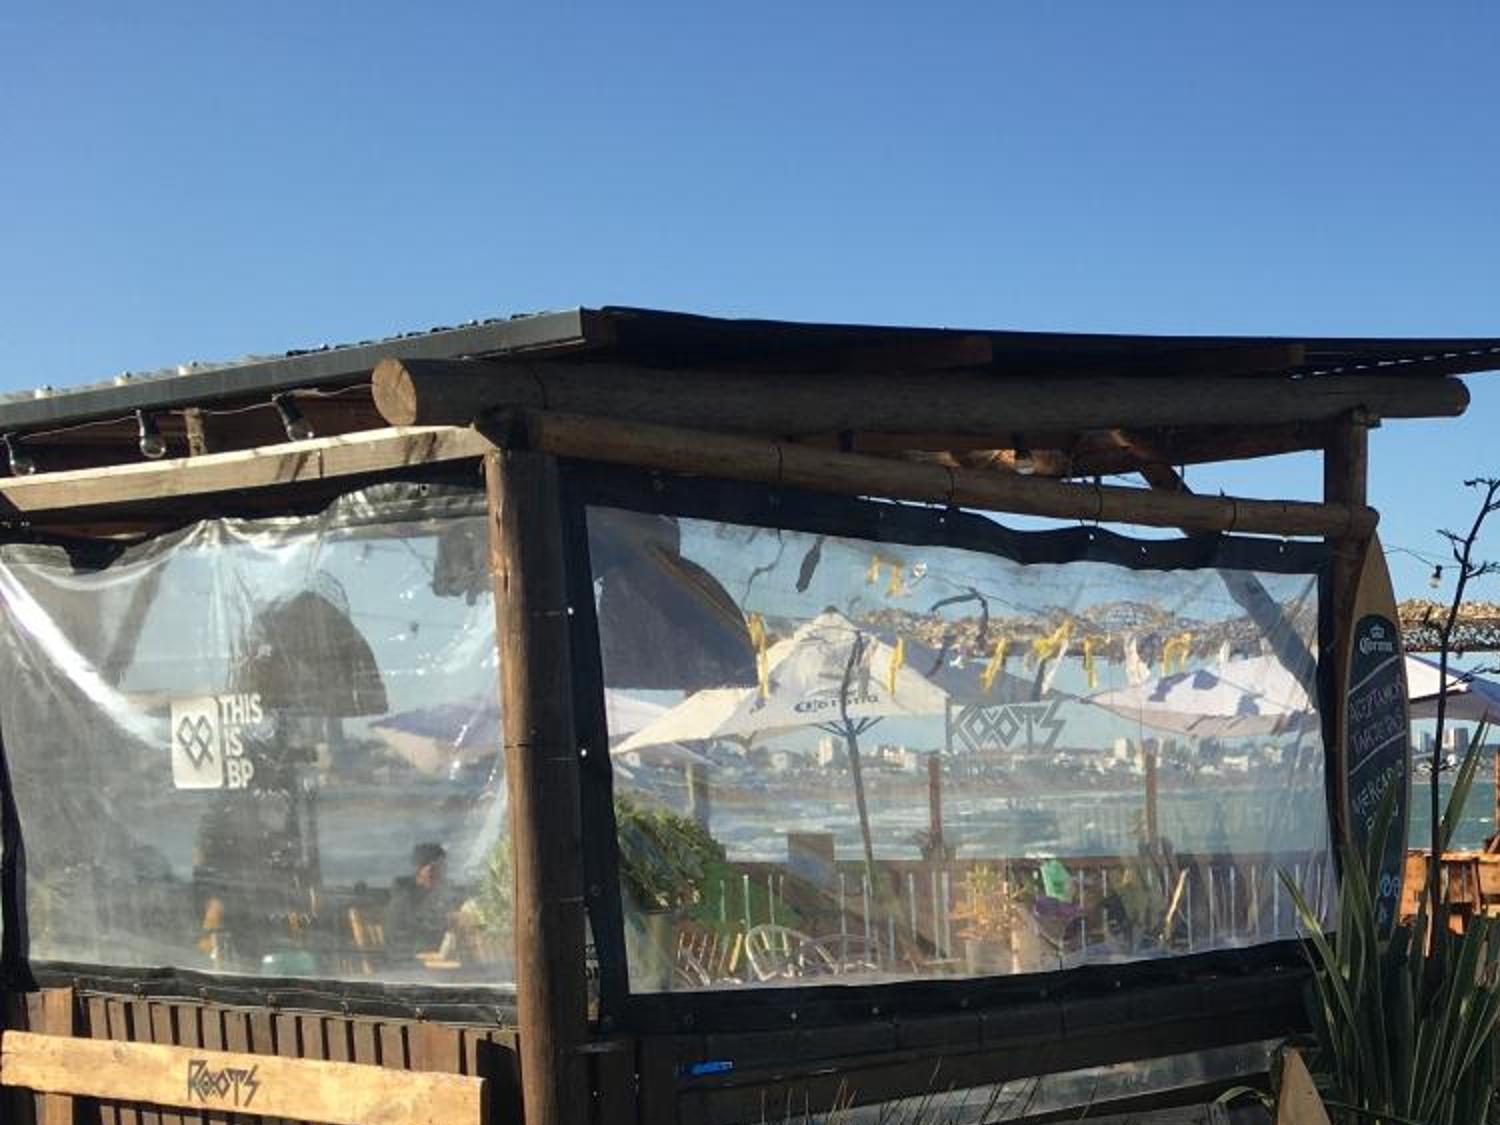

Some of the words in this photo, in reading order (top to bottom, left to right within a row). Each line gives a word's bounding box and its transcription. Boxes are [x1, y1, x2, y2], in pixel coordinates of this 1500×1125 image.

[221, 694, 263, 725] THIS
[225, 727, 243, 758] IS
[226, 760, 254, 790] BP
